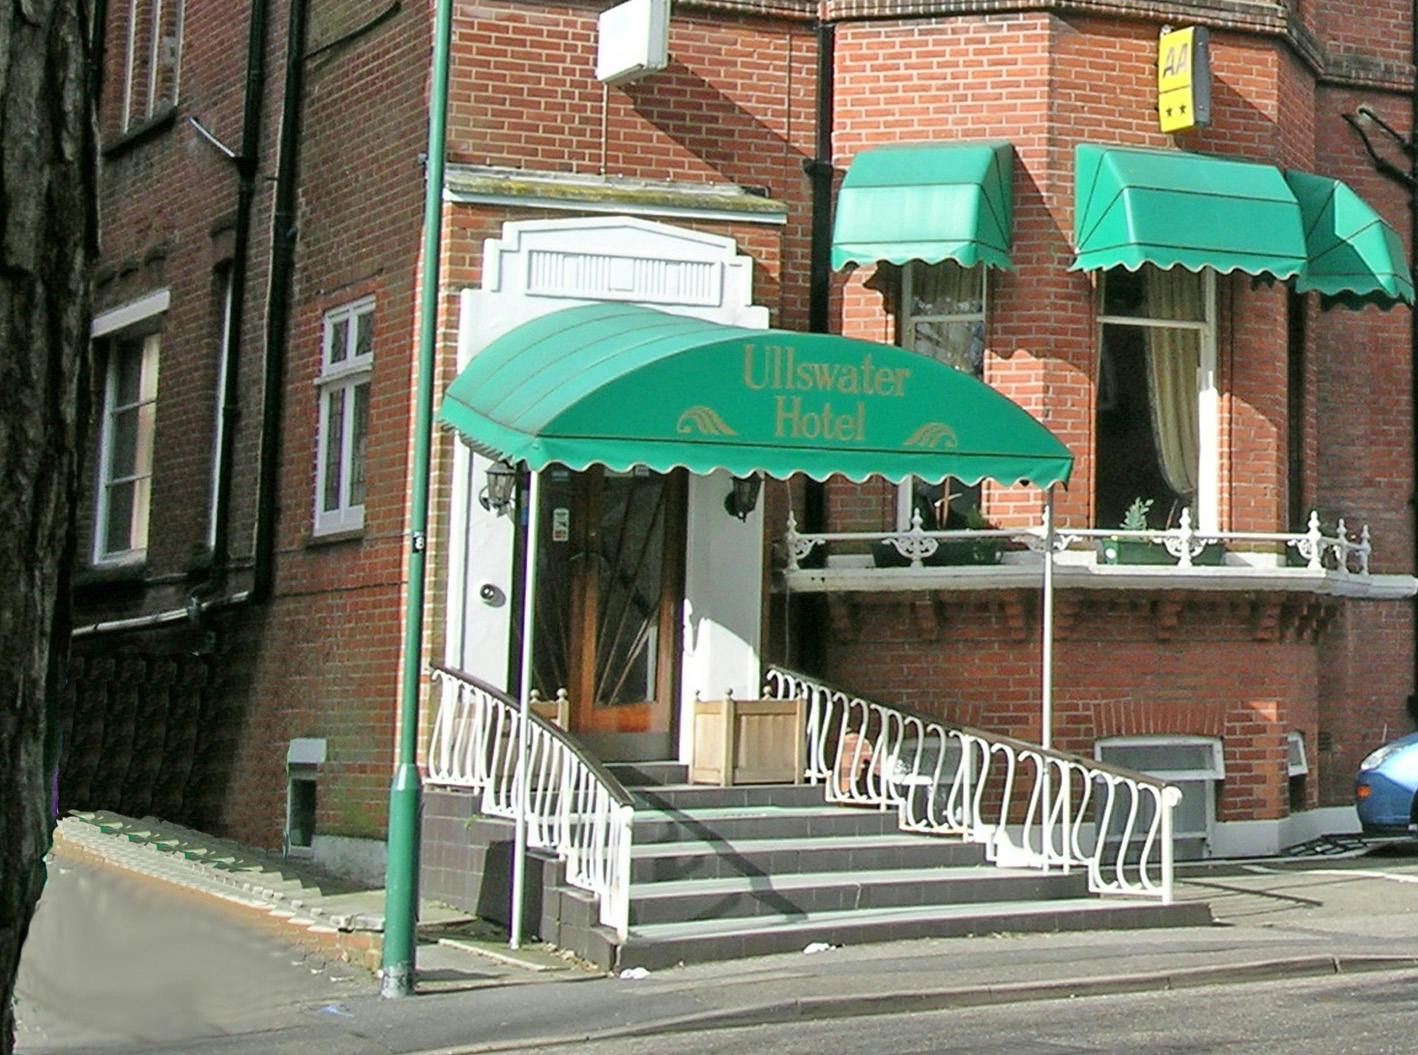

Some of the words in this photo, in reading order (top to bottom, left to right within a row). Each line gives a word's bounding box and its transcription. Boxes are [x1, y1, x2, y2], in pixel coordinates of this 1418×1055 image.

[1163, 43, 1188, 78] AA
[742, 343, 912, 397] Ullswater
[774, 394, 867, 442] Hotel
